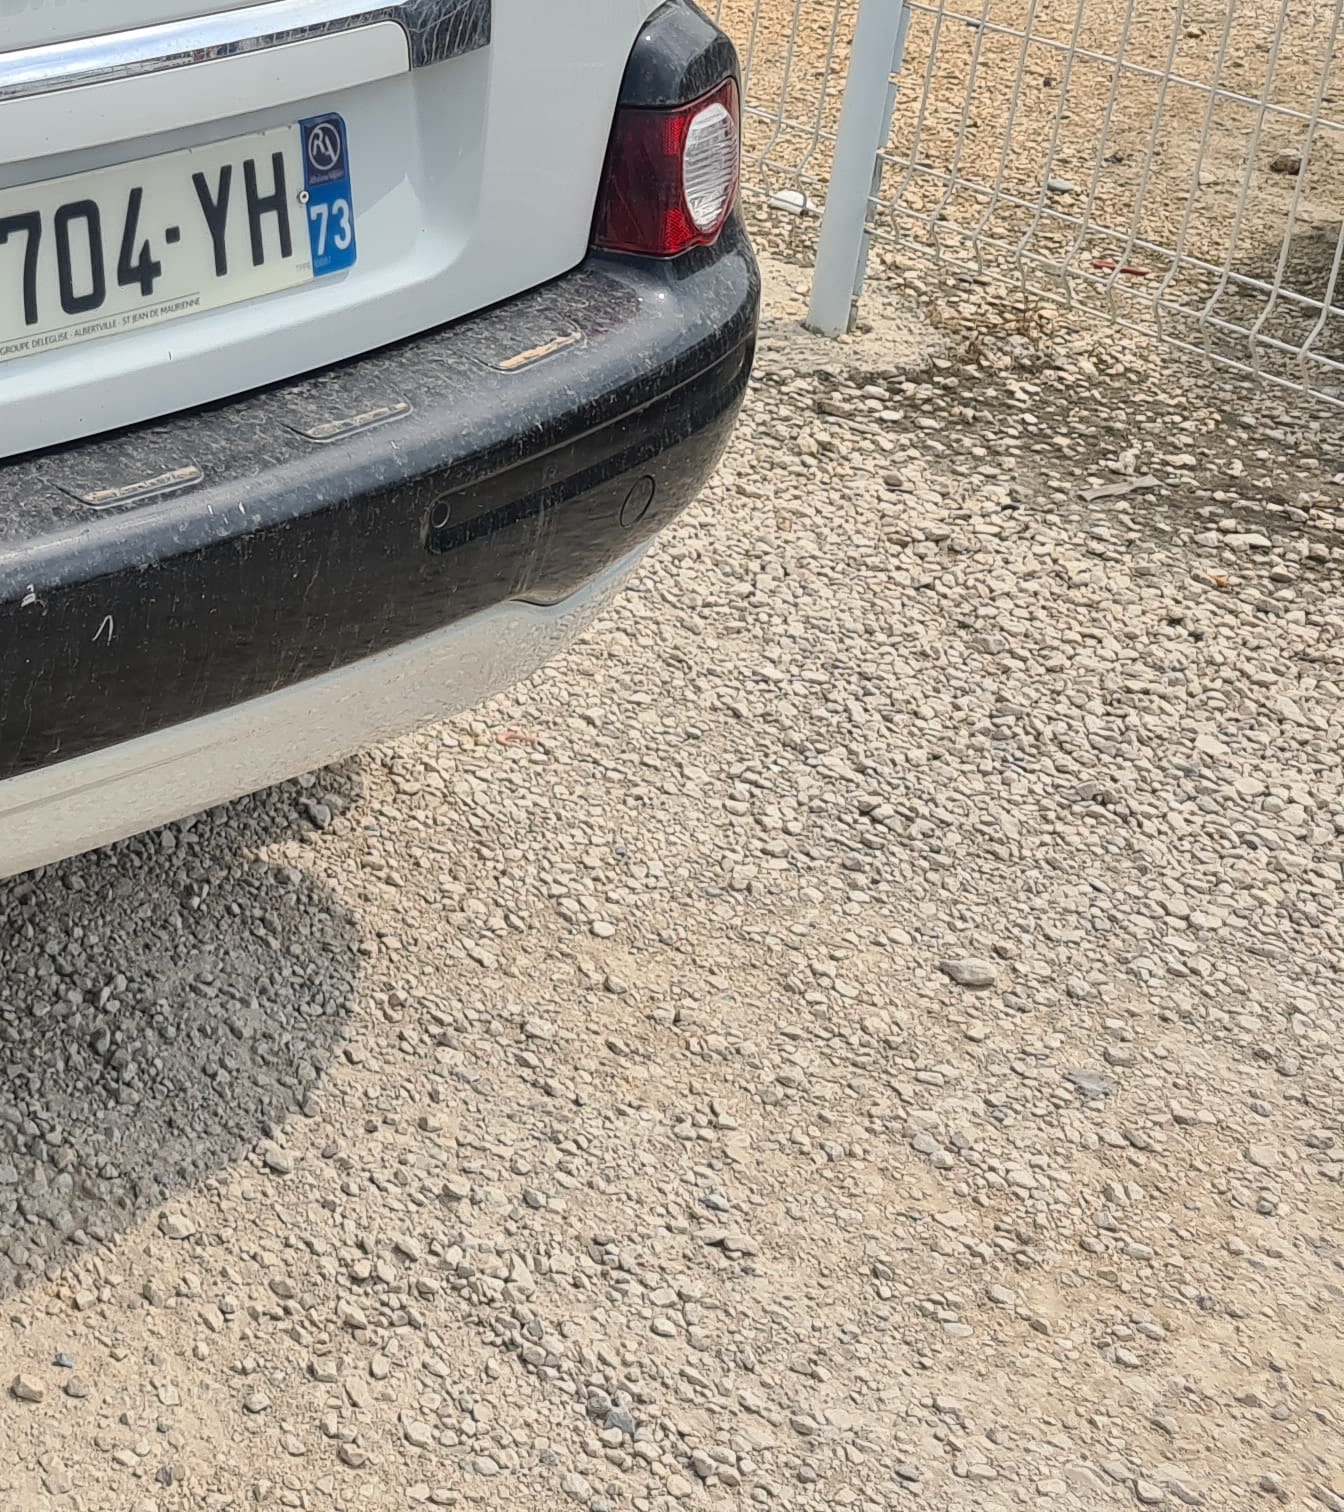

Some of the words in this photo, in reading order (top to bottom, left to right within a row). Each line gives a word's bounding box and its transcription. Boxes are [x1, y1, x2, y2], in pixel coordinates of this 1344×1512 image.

[310, 198, 352, 256] 73
[0, 341, 31, 356] GROUPE
[73, 319, 117, 337] ALBERTVILLE
[122, 316, 131, 326] ST
[132, 310, 149, 324] JEAN
[149, 308, 160, 318] DE
[160, 297, 201, 315] MAURIENNE
